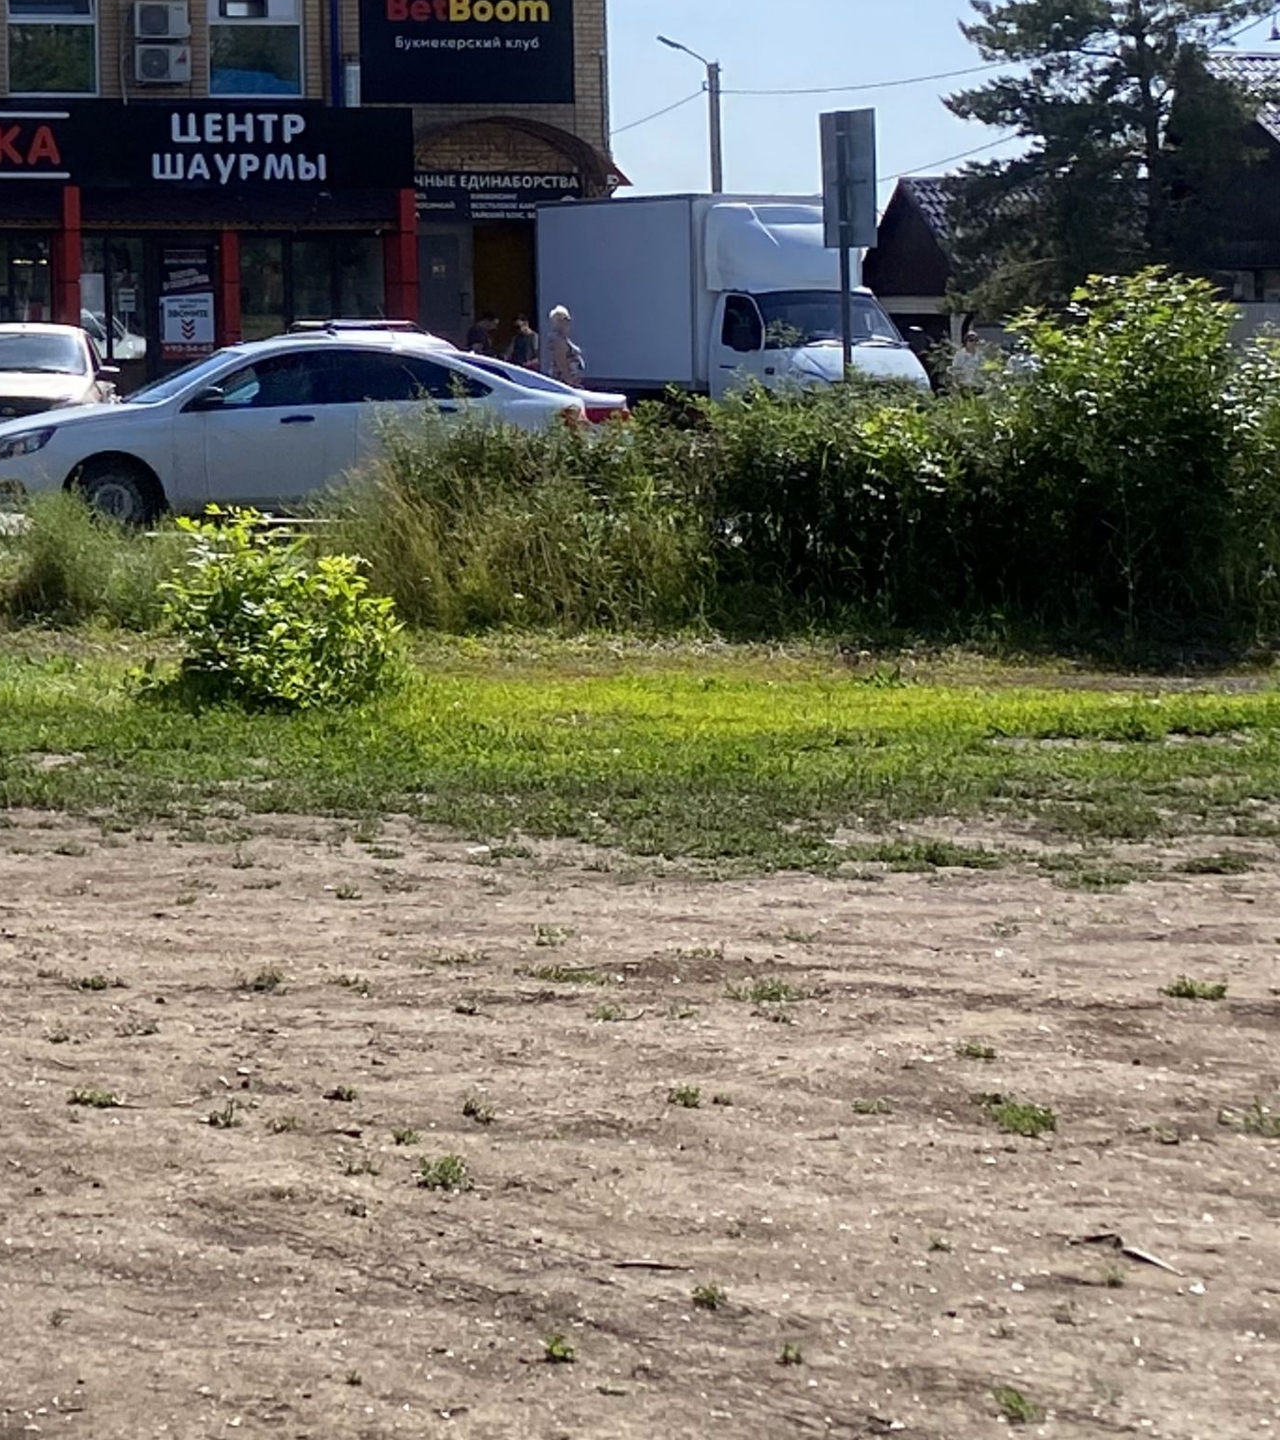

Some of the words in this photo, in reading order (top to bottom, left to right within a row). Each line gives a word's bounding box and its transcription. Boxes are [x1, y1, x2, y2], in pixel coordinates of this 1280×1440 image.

[395, 35, 501, 50] Букмекерский
[505, 36, 540, 51] клуб
[171, 112, 306, 143] ЦЕНТР
[152, 153, 327, 185] ШАУРМЫ
